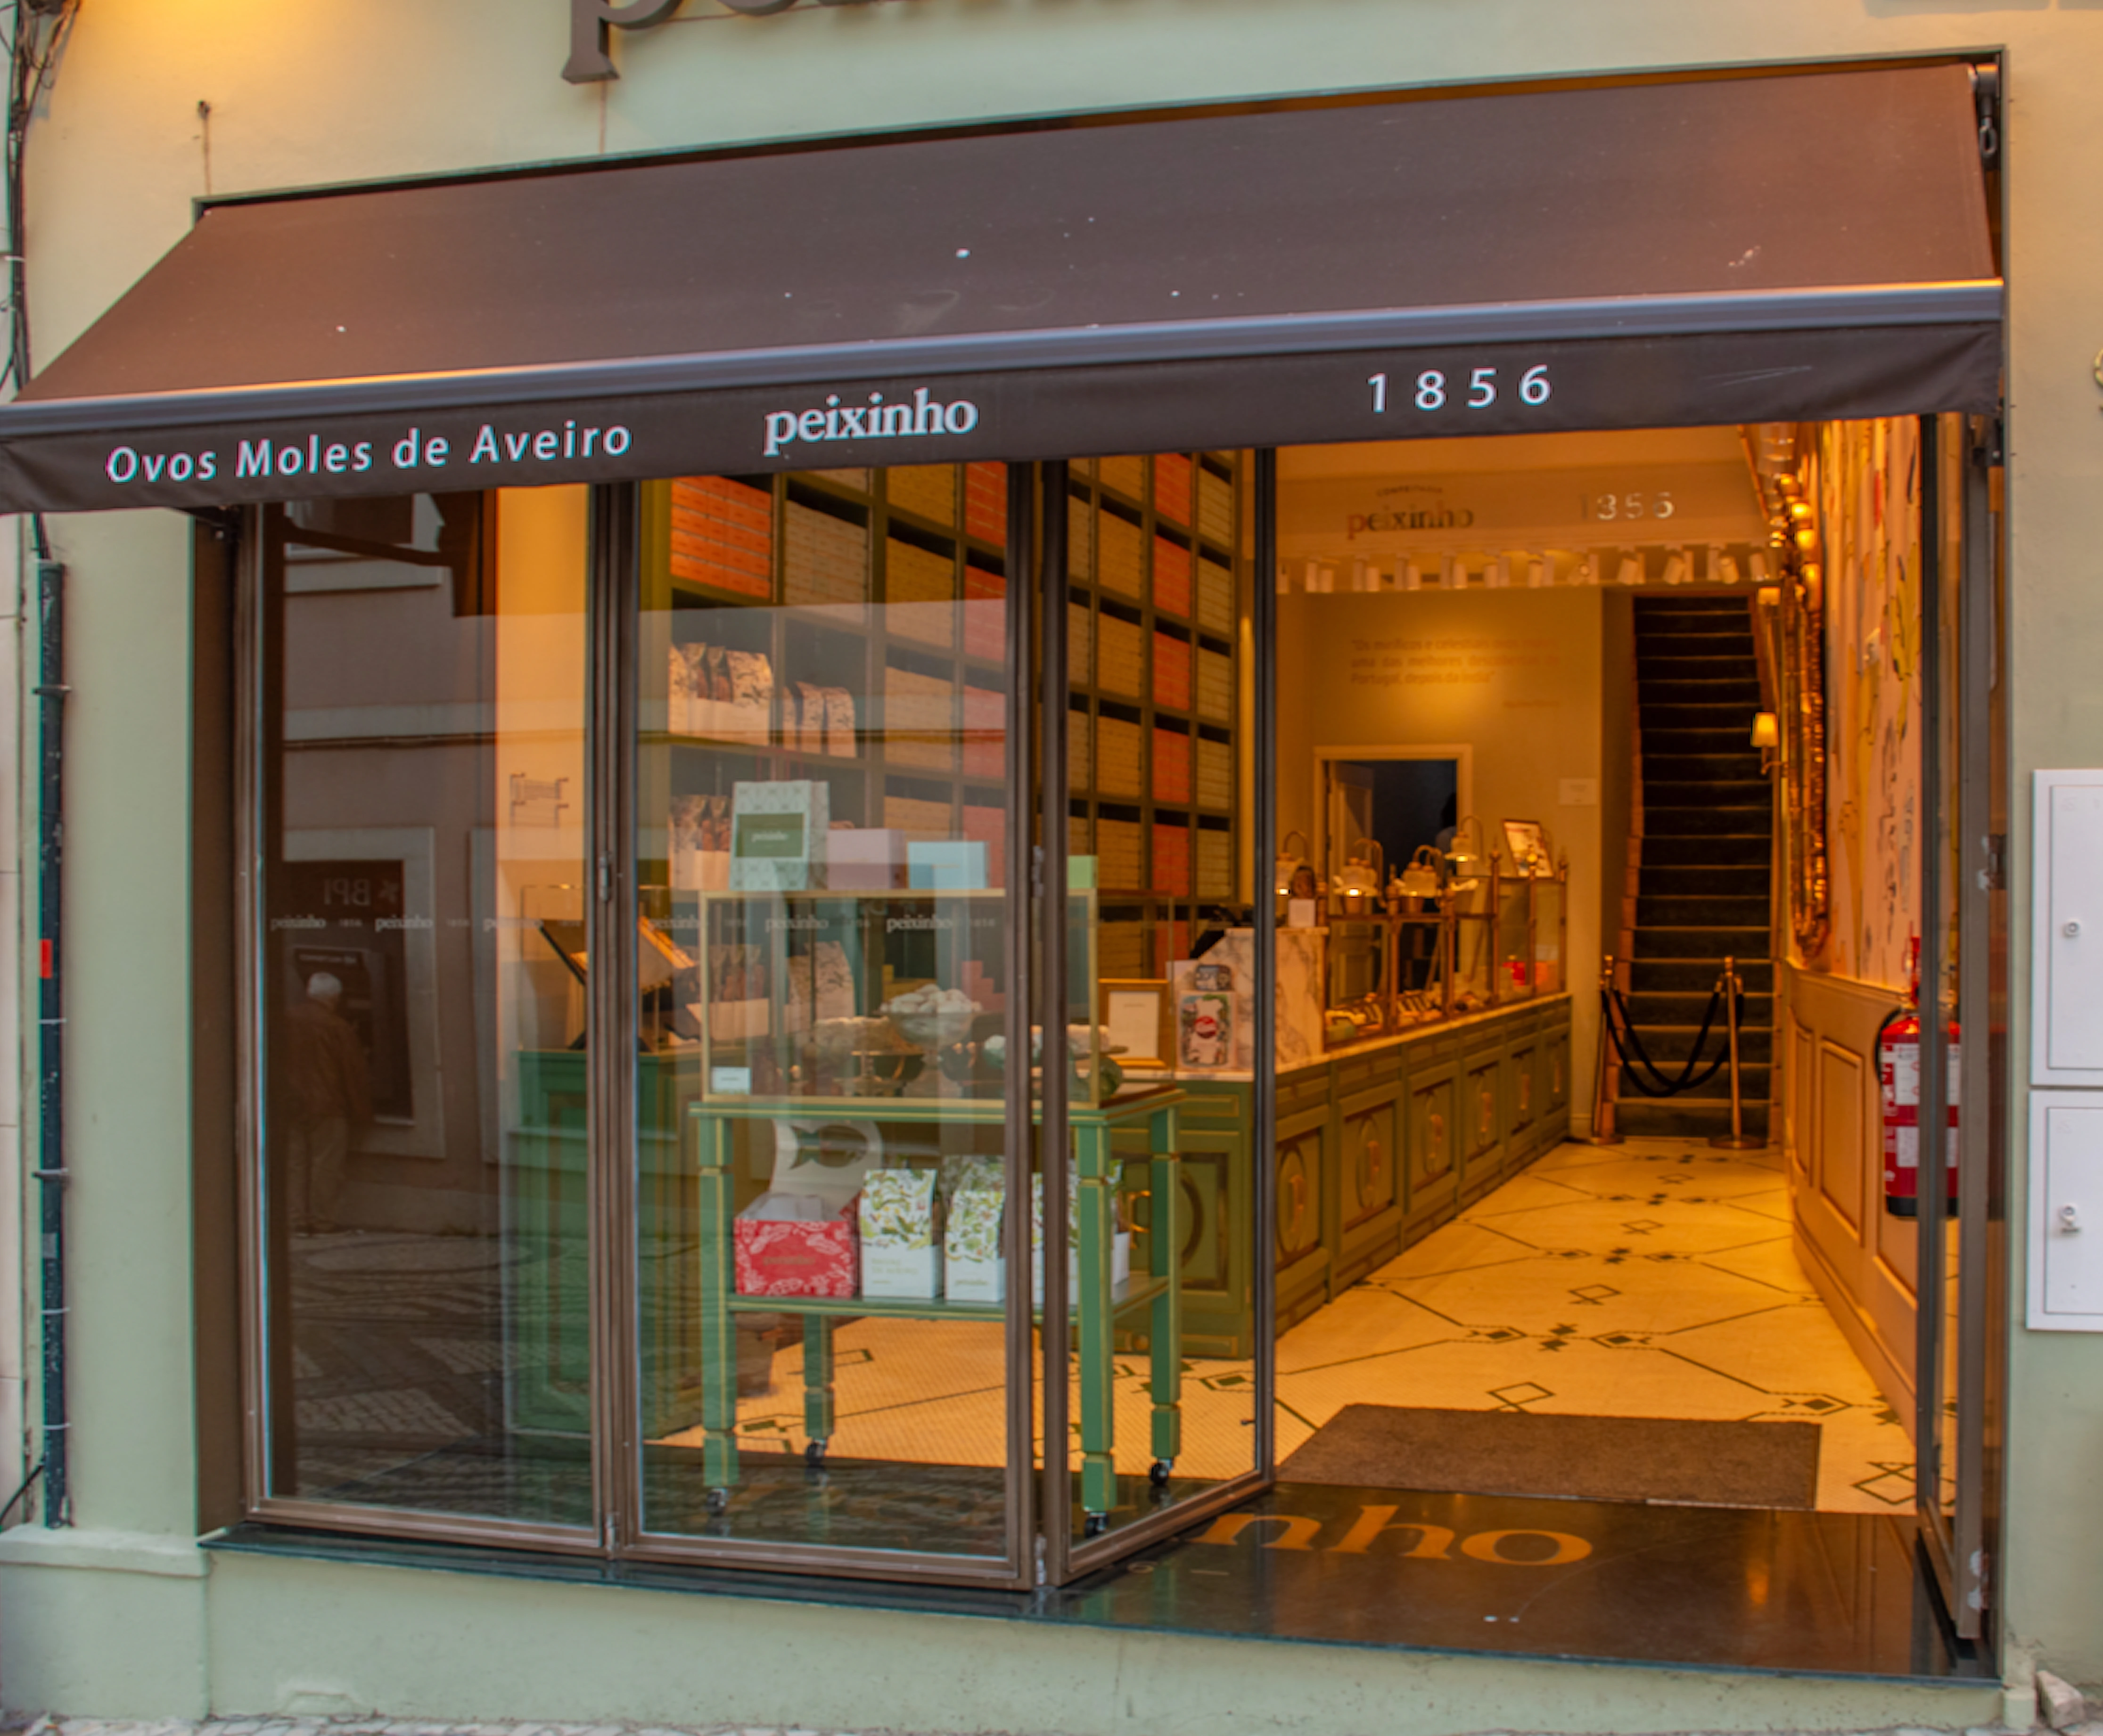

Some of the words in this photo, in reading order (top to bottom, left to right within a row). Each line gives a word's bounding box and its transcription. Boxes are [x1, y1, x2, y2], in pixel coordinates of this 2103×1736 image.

[1368, 364, 1551, 412] 1856
[764, 387, 978, 457] peixinho
[107, 447, 214, 483] Ovos
[236, 434, 370, 478] Moles
[393, 427, 447, 467] de
[469, 420, 629, 463] Aveiro
[1347, 500, 1475, 541] peixinho
